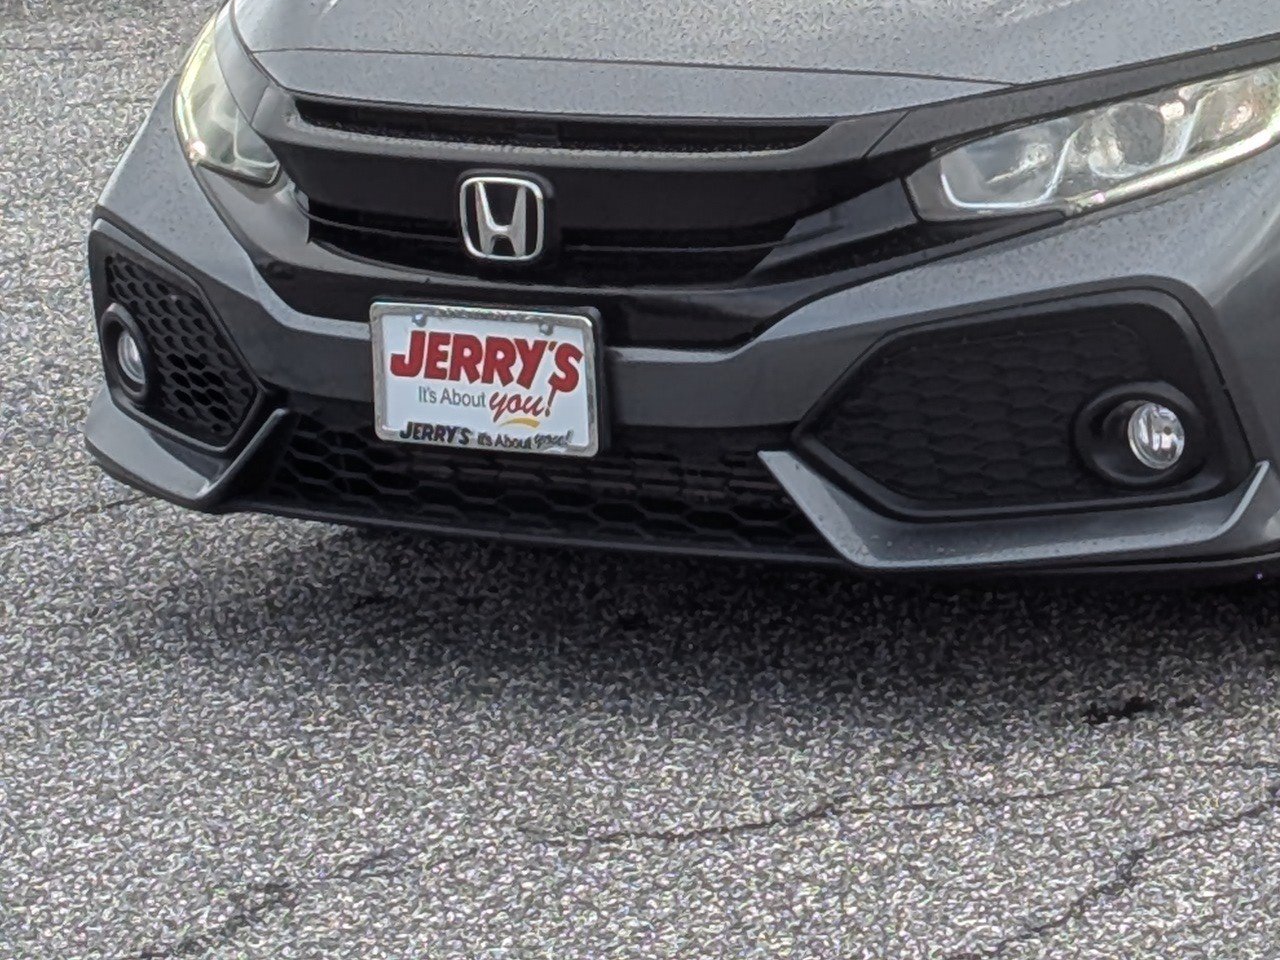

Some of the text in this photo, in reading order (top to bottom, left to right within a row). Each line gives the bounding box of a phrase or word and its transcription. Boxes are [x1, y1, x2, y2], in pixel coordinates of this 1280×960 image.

[390, 330, 584, 392] JERRY'S
[418, 386, 557, 423] It's About you!
[400, 421, 473, 445] JERRY'S
